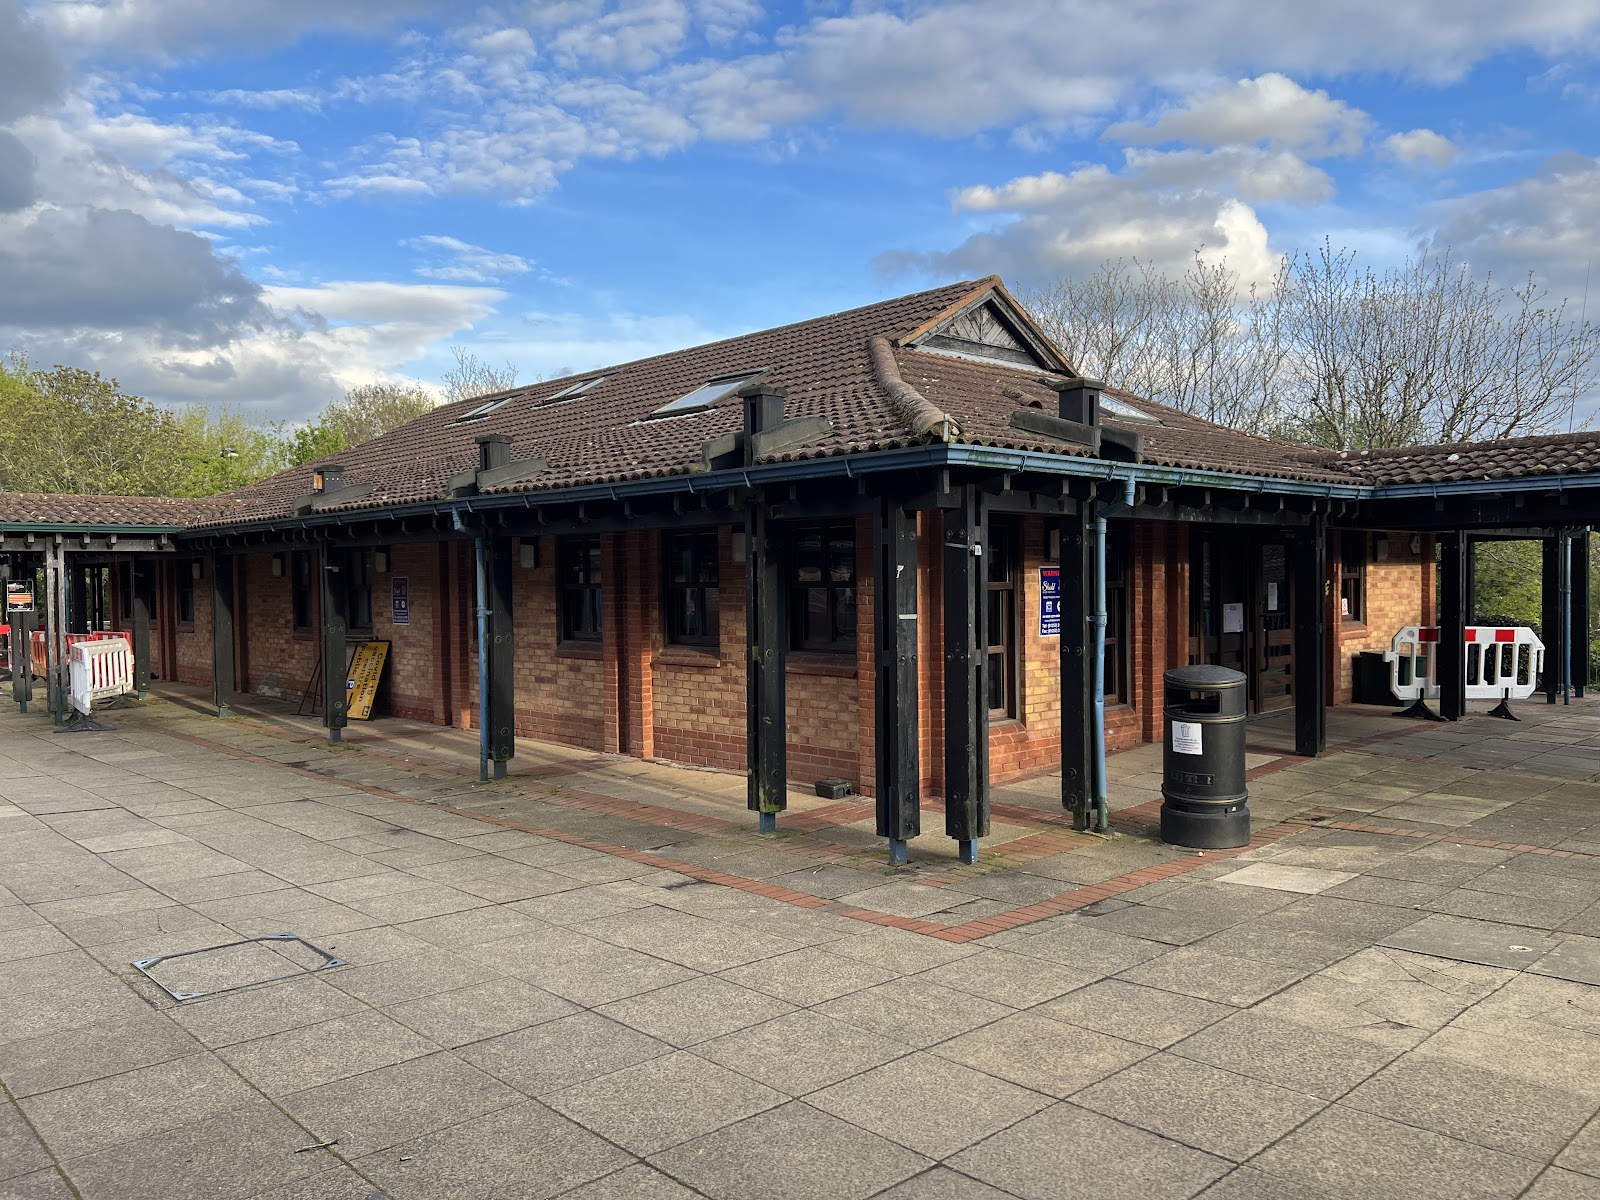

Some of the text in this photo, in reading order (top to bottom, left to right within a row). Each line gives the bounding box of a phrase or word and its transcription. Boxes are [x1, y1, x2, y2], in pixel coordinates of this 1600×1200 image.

[356, 658, 369, 690] centre
[358, 645, 378, 702] vaccination
[367, 653, 383, 696] Covid-19
